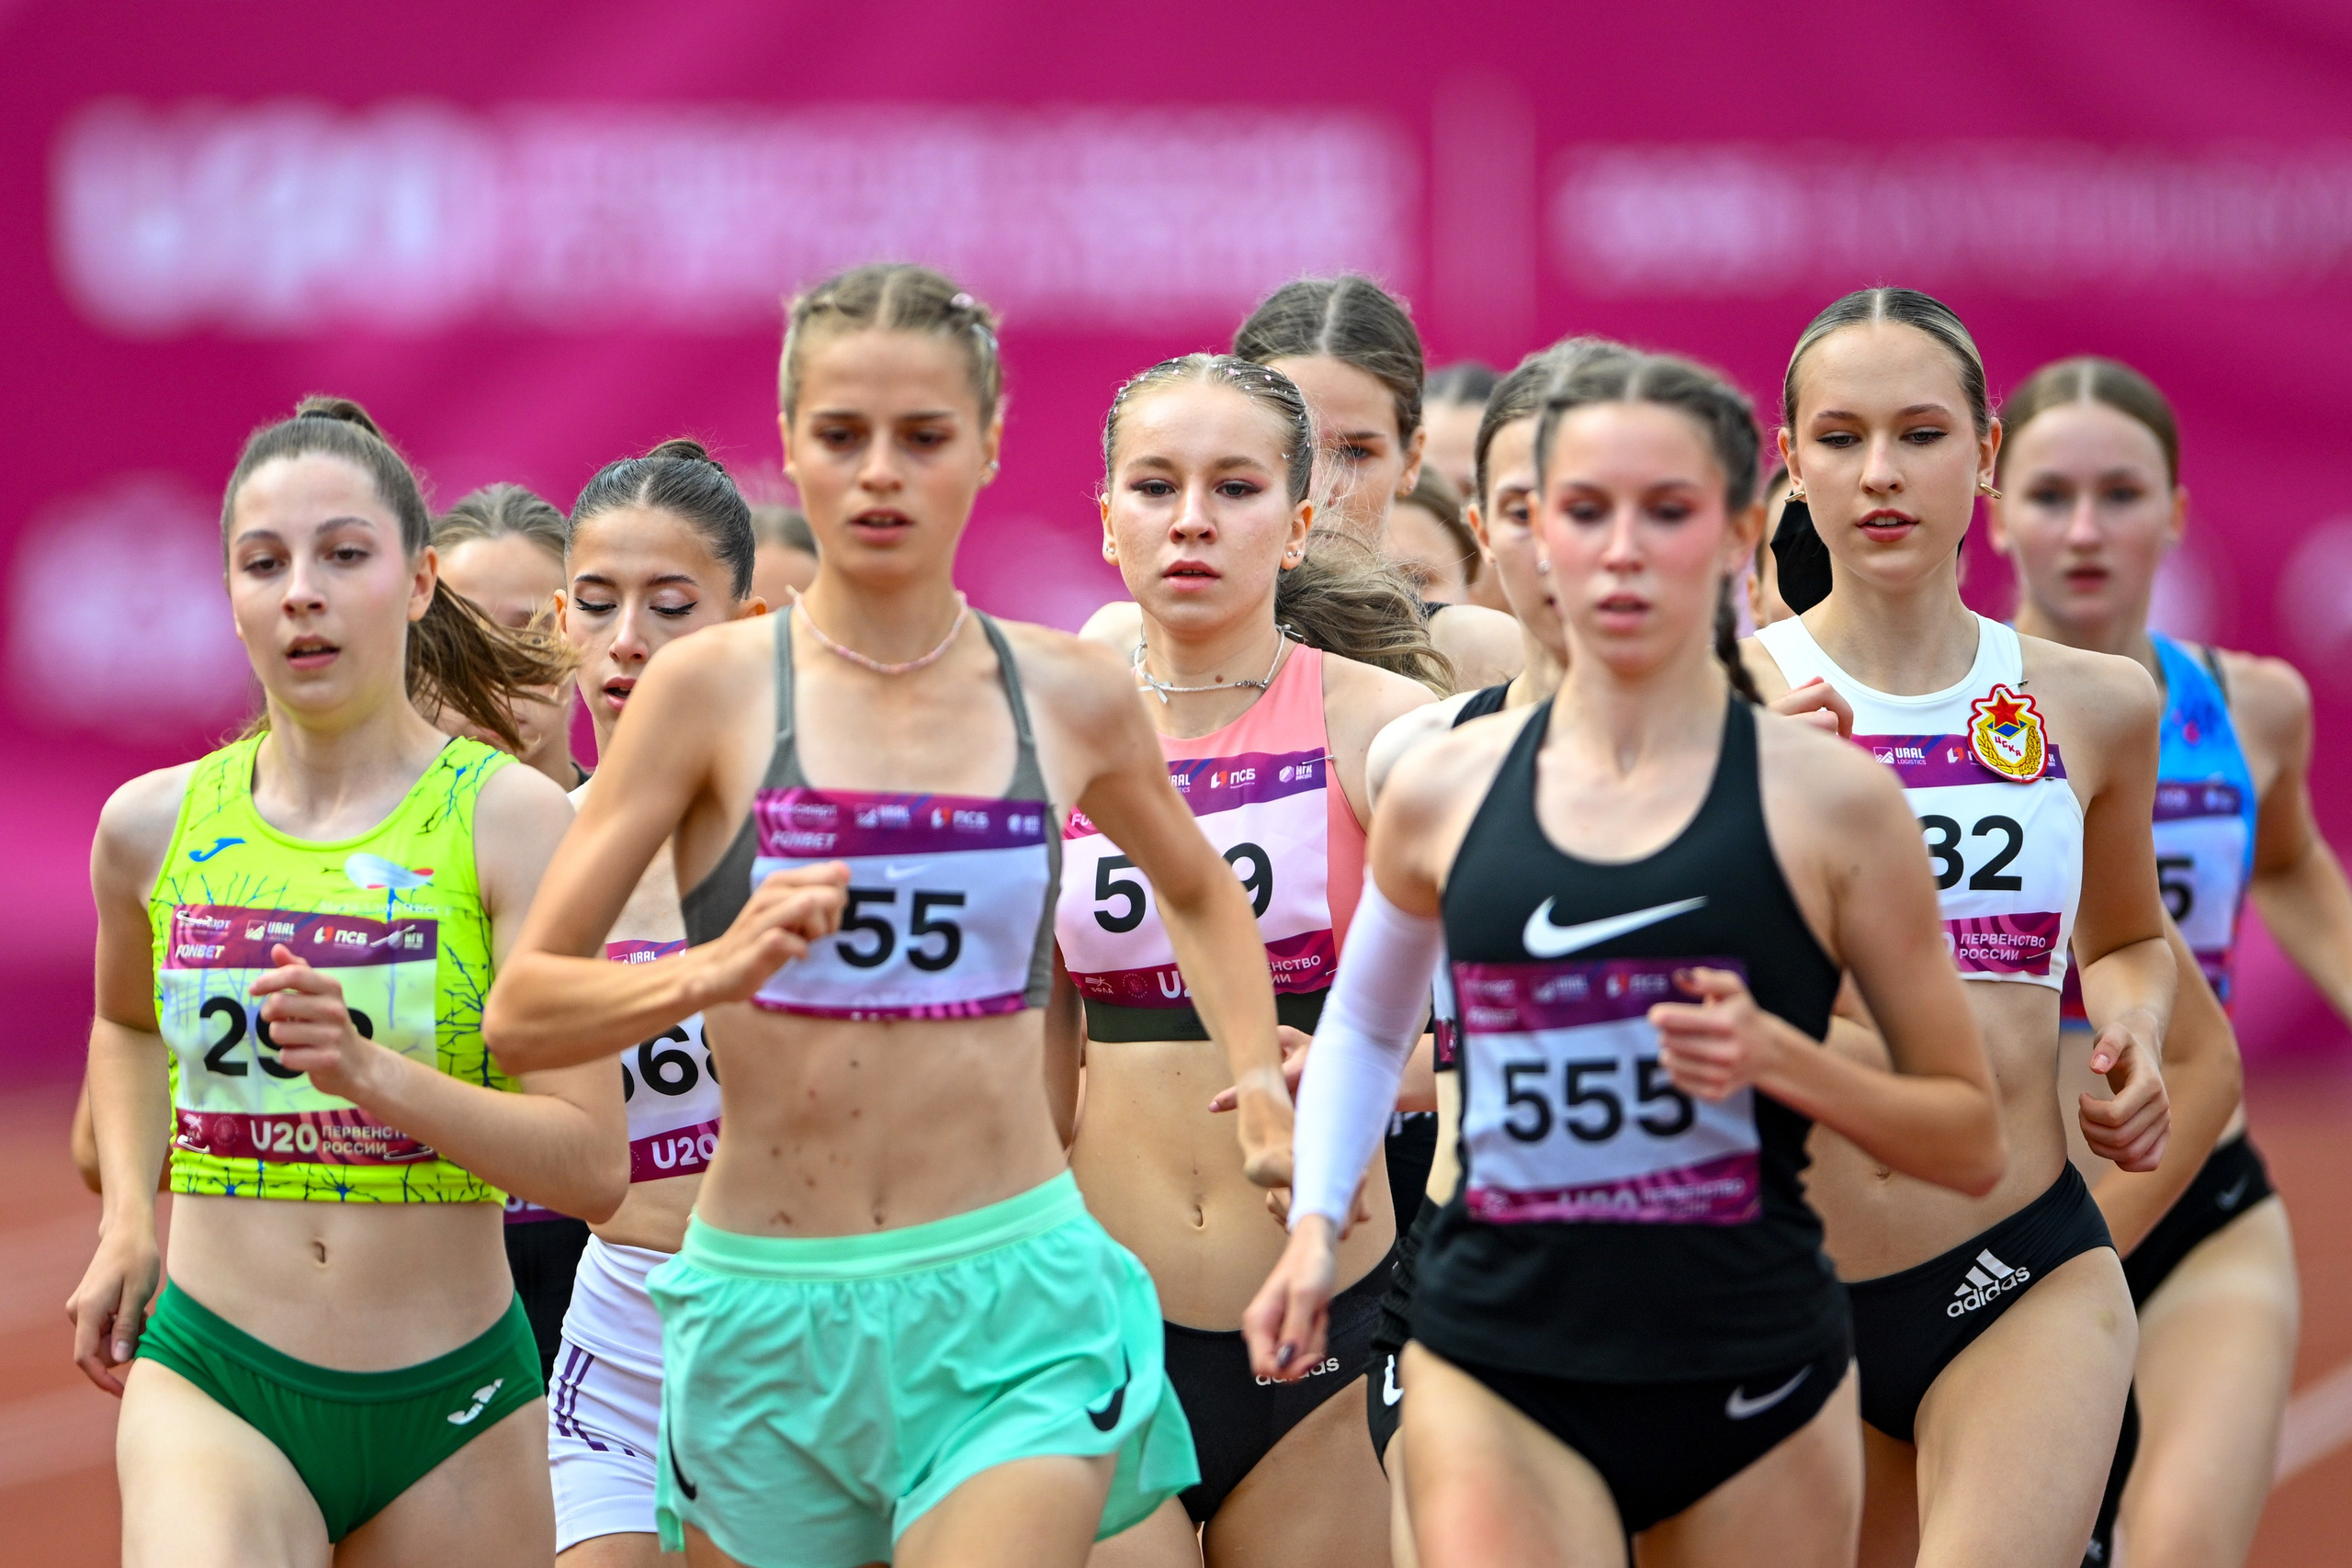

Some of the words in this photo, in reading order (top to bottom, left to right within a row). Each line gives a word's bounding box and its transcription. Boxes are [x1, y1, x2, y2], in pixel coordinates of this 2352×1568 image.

[1895, 748, 1925, 759] URAL
[1995, 736, 2022, 757] ЦСКА
[1168, 773, 1191, 786] RAL
[1230, 768, 1256, 784] ПСБ
[1917, 815, 2023, 891] 32
[1094, 842, 1272, 933] 59
[334, 930, 368, 946] ПСБ
[835, 887, 966, 971] 55
[1960, 933, 2046, 948] ПЕРВЕНСТВО
[175, 944, 225, 959] FONBET
[629, 951, 657, 964] URAL
[1959, 948, 2019, 961] РОССИИ
[1503, 1057, 1695, 1143] 555
[251, 1120, 319, 1154] U20
[322, 1141, 387, 1155] РОССИИ
[651, 1133, 720, 1170] U20
[1947, 1266, 2030, 1317] adidas
[1255, 1358, 1340, 1386] aas
